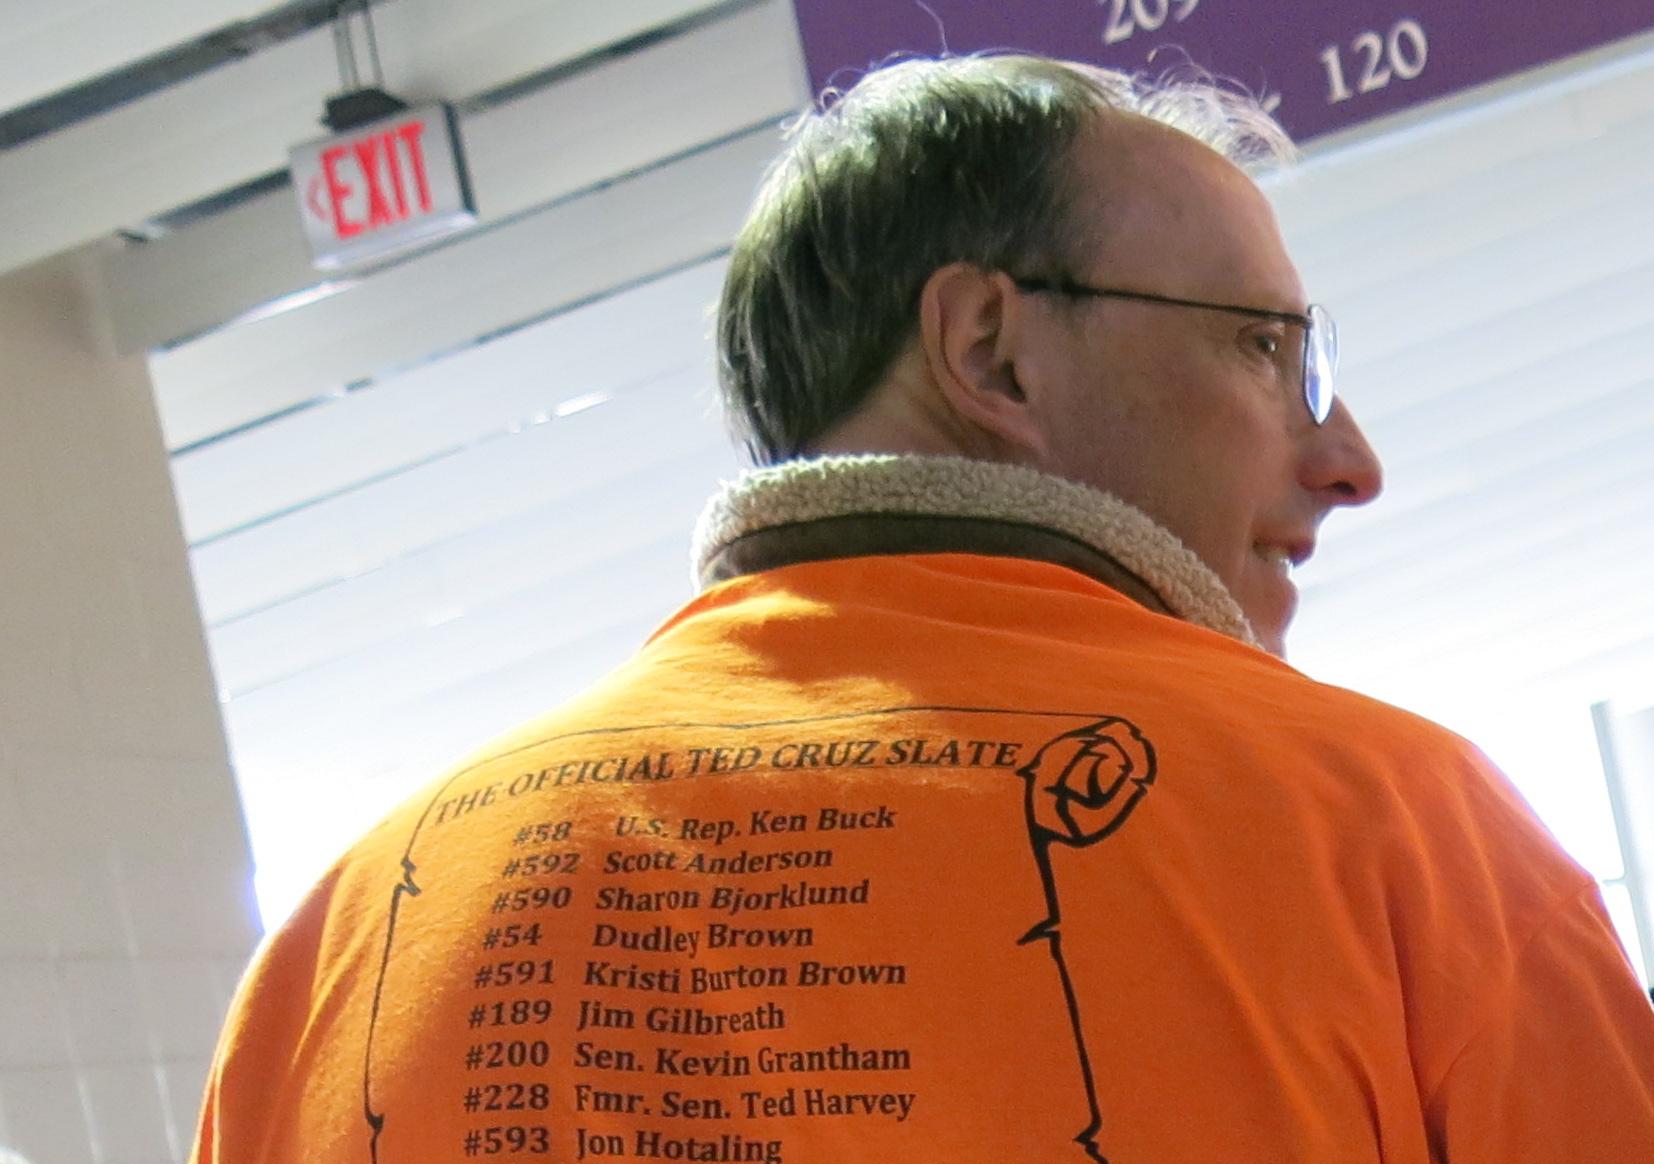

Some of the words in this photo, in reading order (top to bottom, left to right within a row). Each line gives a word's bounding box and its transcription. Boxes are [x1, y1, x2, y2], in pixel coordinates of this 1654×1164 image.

[1321, 19, 1428, 104] 120
[321, 120, 432, 240] EXIT
[435, 782, 503, 824] THE
[508, 752, 675, 796] OFFICIAL
[687, 746, 764, 773] TED
[771, 742, 880, 768] CRUZ
[884, 739, 1024, 768] SLATE
[512, 821, 572, 845] #58
[616, 816, 668, 837] U.S.
[678, 817, 740, 844] Rep.
[750, 810, 809, 837] Ken
[817, 806, 896, 831] Buck
[502, 852, 580, 879] #592
[602, 849, 677, 875] Scott
[686, 846, 833, 873] Anderson
[491, 887, 572, 913] #590
[595, 885, 700, 911] Sharon
[709, 879, 870, 914] Bjorklund
[482, 924, 542, 950] #54
[592, 924, 700, 956] Dudley
[707, 925, 813, 949] Brown
[474, 961, 556, 988] #591
[583, 962, 681, 994] Kristi
[690, 963, 788, 995] Burton
[796, 961, 907, 989] Brown
[468, 1001, 552, 1029] #189
[575, 1001, 635, 1033] Jim
[645, 1003, 785, 1037] Gilbreath
[465, 1041, 550, 1071] #200
[573, 1042, 644, 1072] Sen.
[656, 1049, 751, 1077] Kevin
[756, 1042, 911, 1073] Grantham
[463, 1084, 550, 1113] #228
[574, 1085, 652, 1116] Fmr.
[661, 1091, 732, 1120] Sen.
[740, 1089, 796, 1117] Ted
[805, 1089, 916, 1122] Harvey
[464, 1127, 550, 1156] #593
[576, 1128, 625, 1160] Jon
